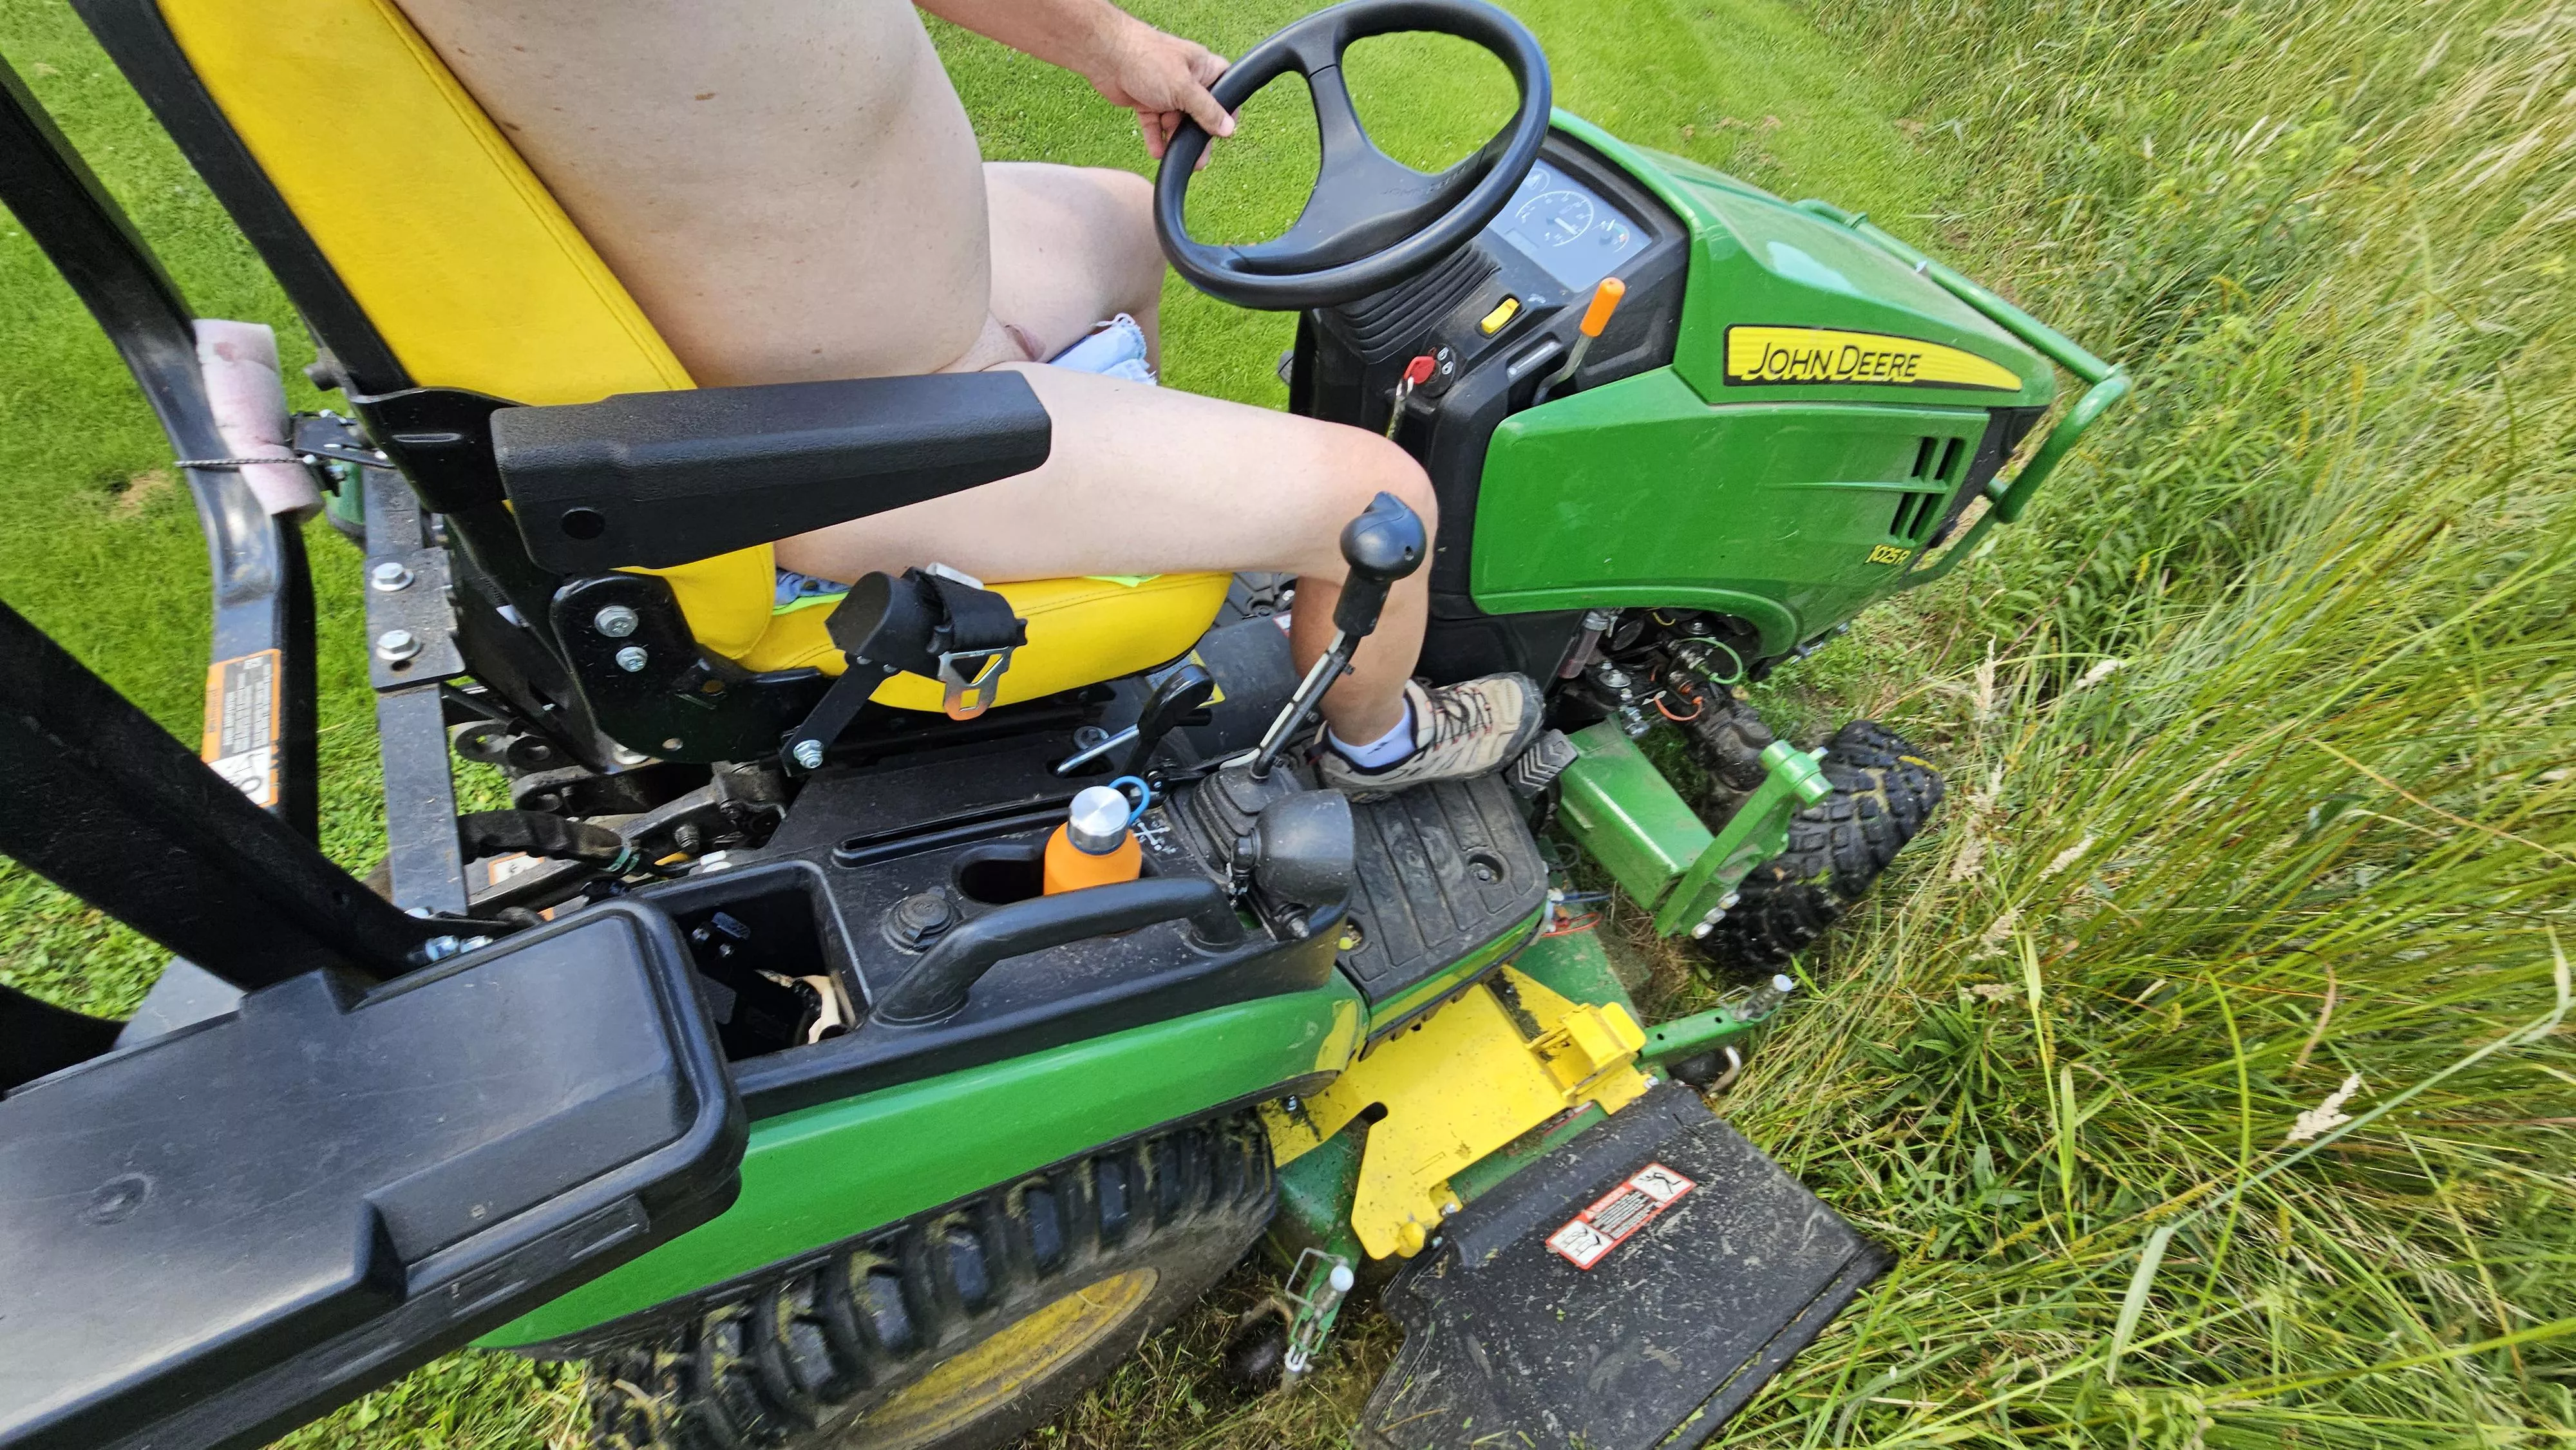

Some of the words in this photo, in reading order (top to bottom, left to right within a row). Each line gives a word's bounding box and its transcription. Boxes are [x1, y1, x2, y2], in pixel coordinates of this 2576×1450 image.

[1747, 342, 1834, 375] JOHN
[1837, 345, 1922, 377] DEERE
[1864, 545, 1911, 565] 1025R
